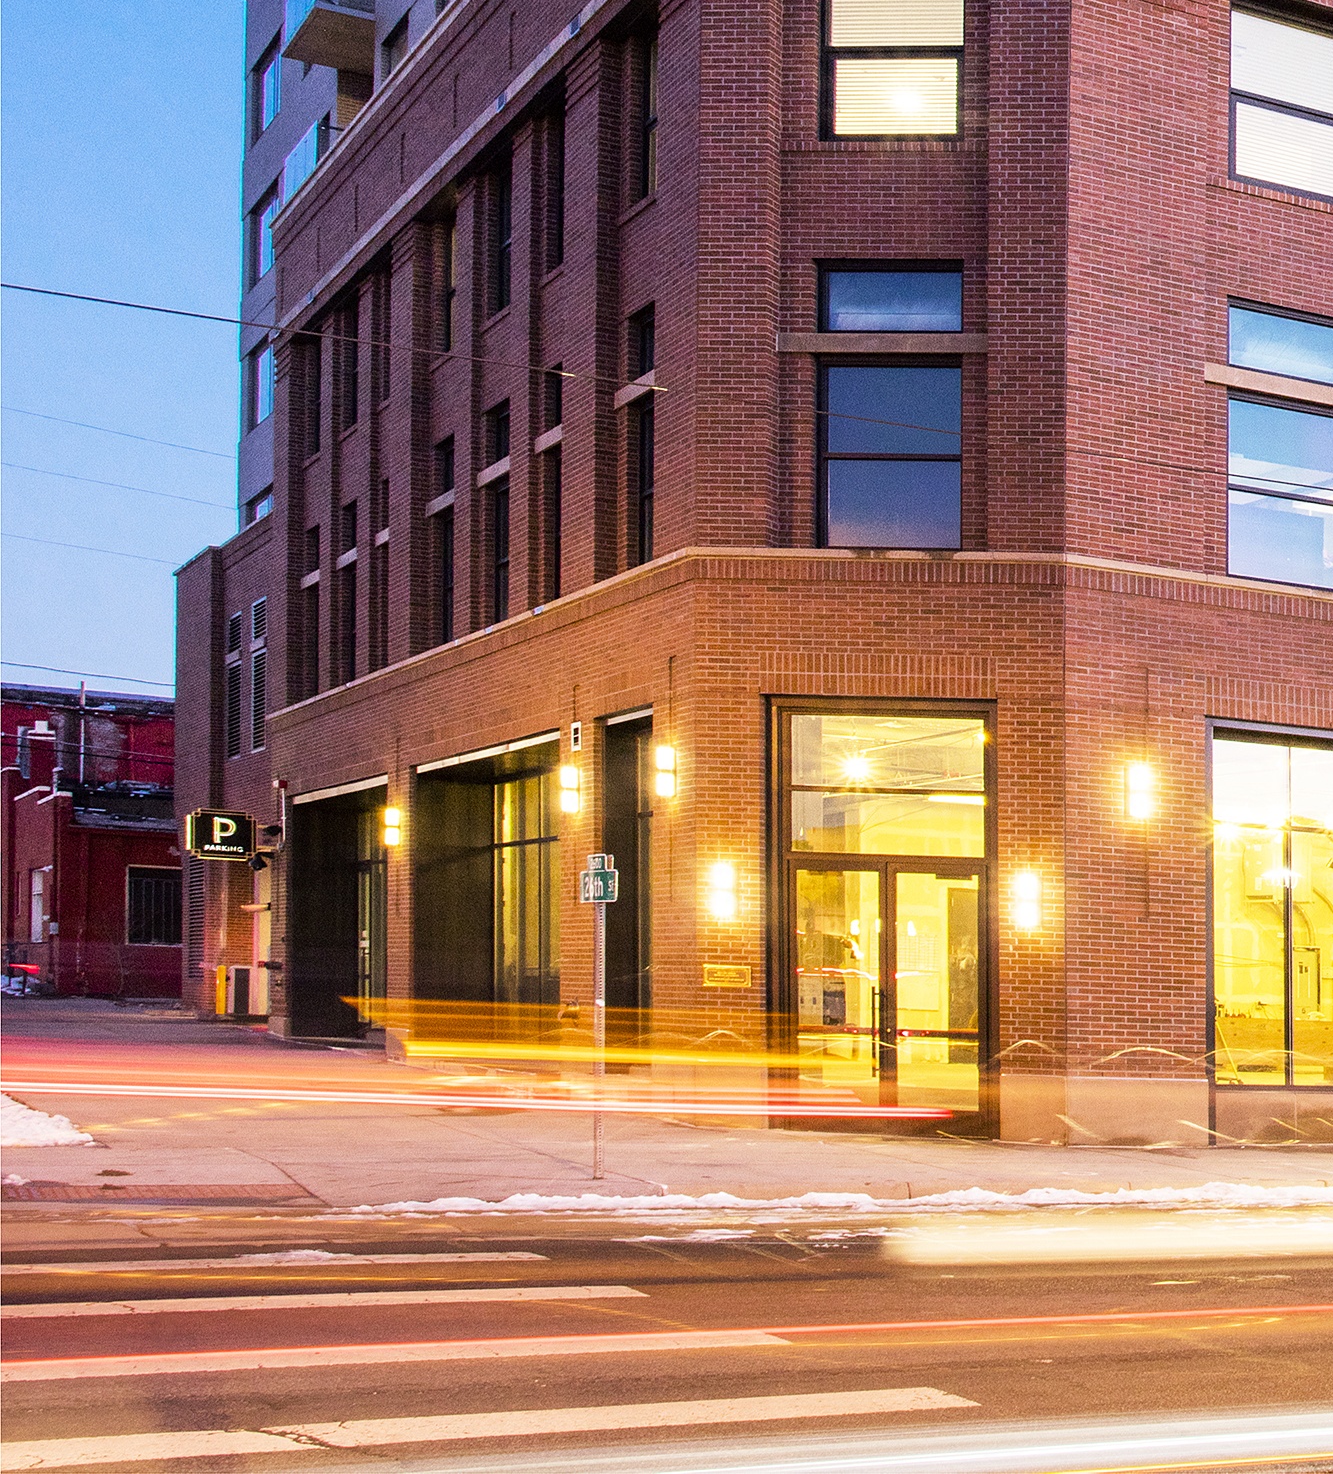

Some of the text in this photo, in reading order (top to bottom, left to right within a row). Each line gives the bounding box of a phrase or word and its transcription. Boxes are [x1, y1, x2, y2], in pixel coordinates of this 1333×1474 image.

[213, 816, 237, 843] P
[204, 844, 244, 853] PARKING
[584, 876, 604, 898] 26th
